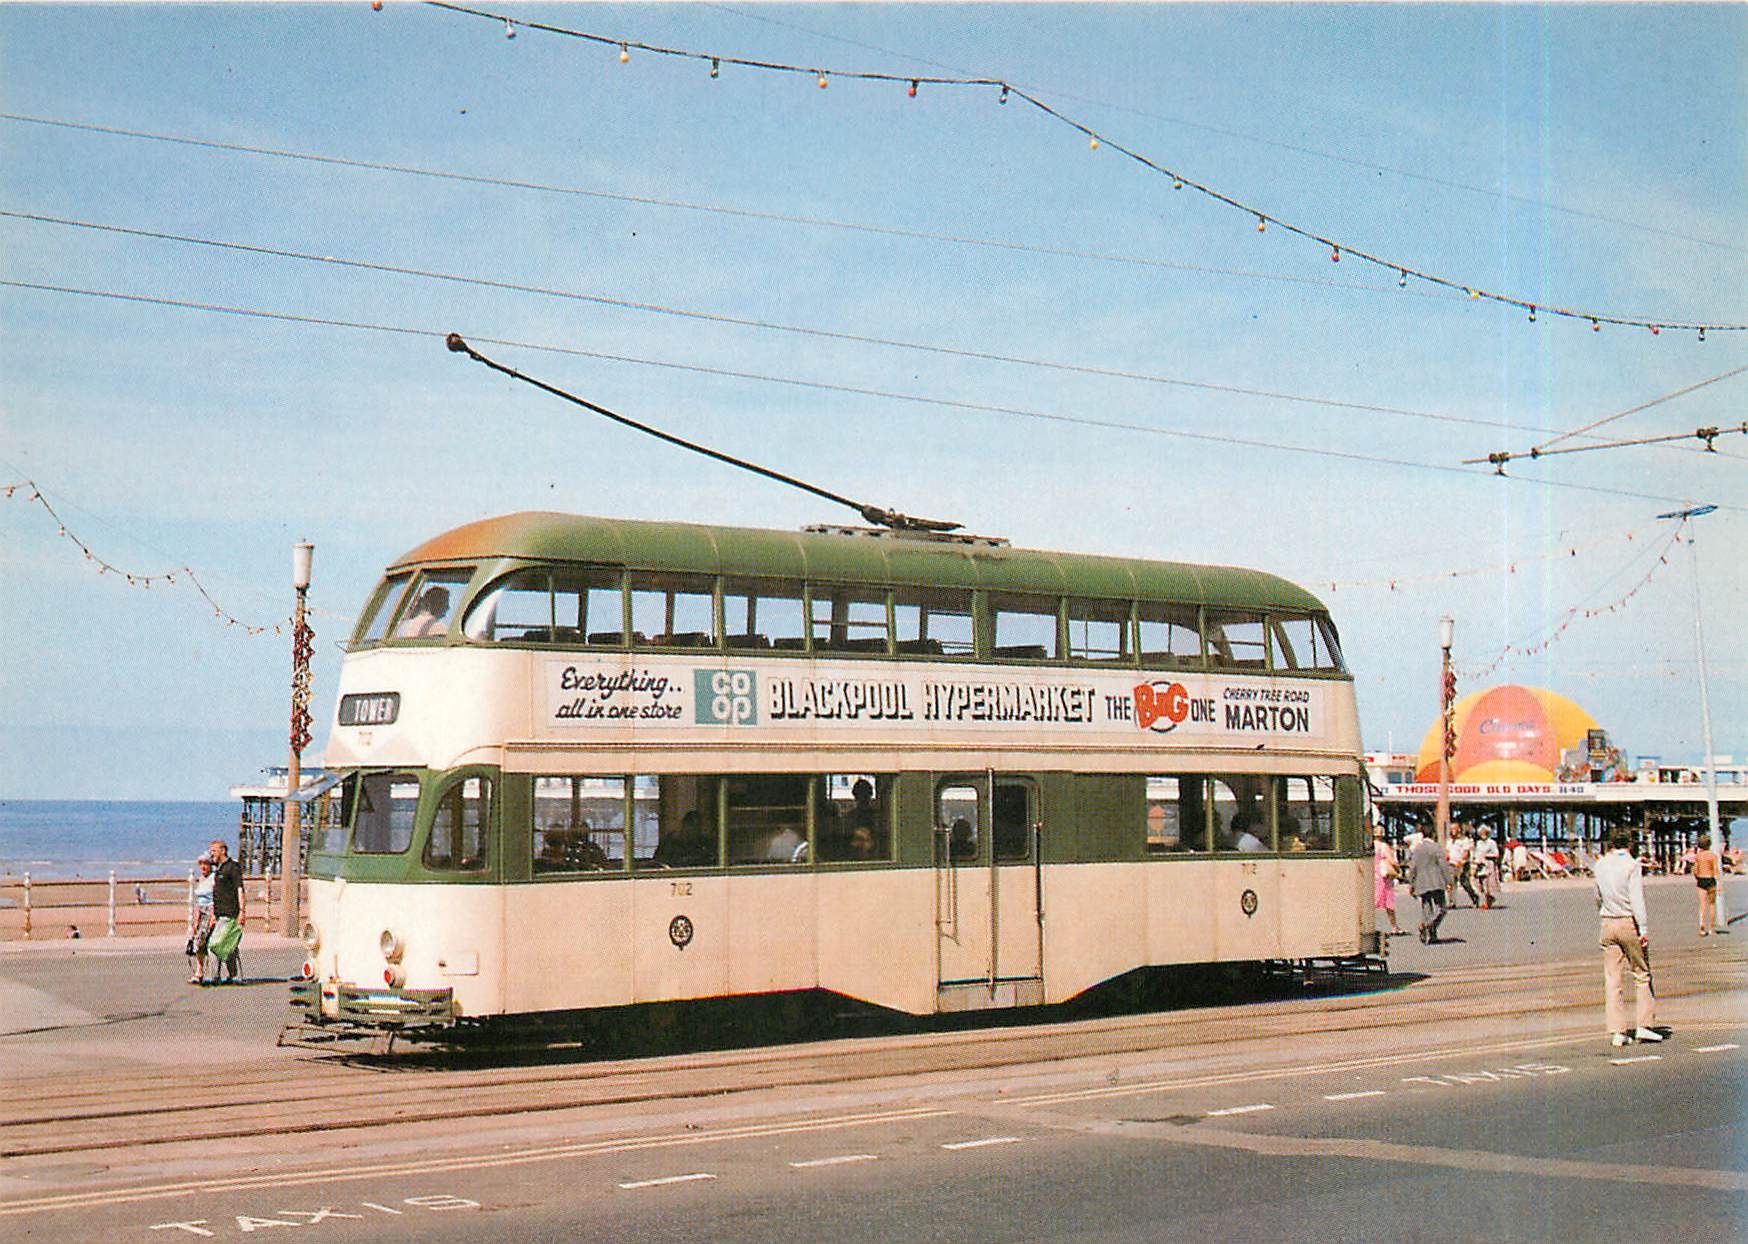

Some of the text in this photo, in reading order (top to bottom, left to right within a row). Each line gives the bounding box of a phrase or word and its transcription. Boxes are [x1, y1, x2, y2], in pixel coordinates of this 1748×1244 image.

[768, 677, 1095, 722] BLACKPOOL HYPERMARKET
[1107, 683, 1216, 729] THE BIG ONE
[1224, 688, 1310, 703] CHERRY TREE ROAD
[354, 697, 394, 722] TOWER
[555, 698, 584, 719] all
[606, 704, 637, 719] one
[640, 701, 682, 719] store
[1225, 704, 1309, 732] MARTON
[1487, 785, 1511, 793] OLD
[1517, 785, 1551, 793] DAYS
[671, 882, 693, 896] 702
[149, 1196, 480, 1237] TAXIS
